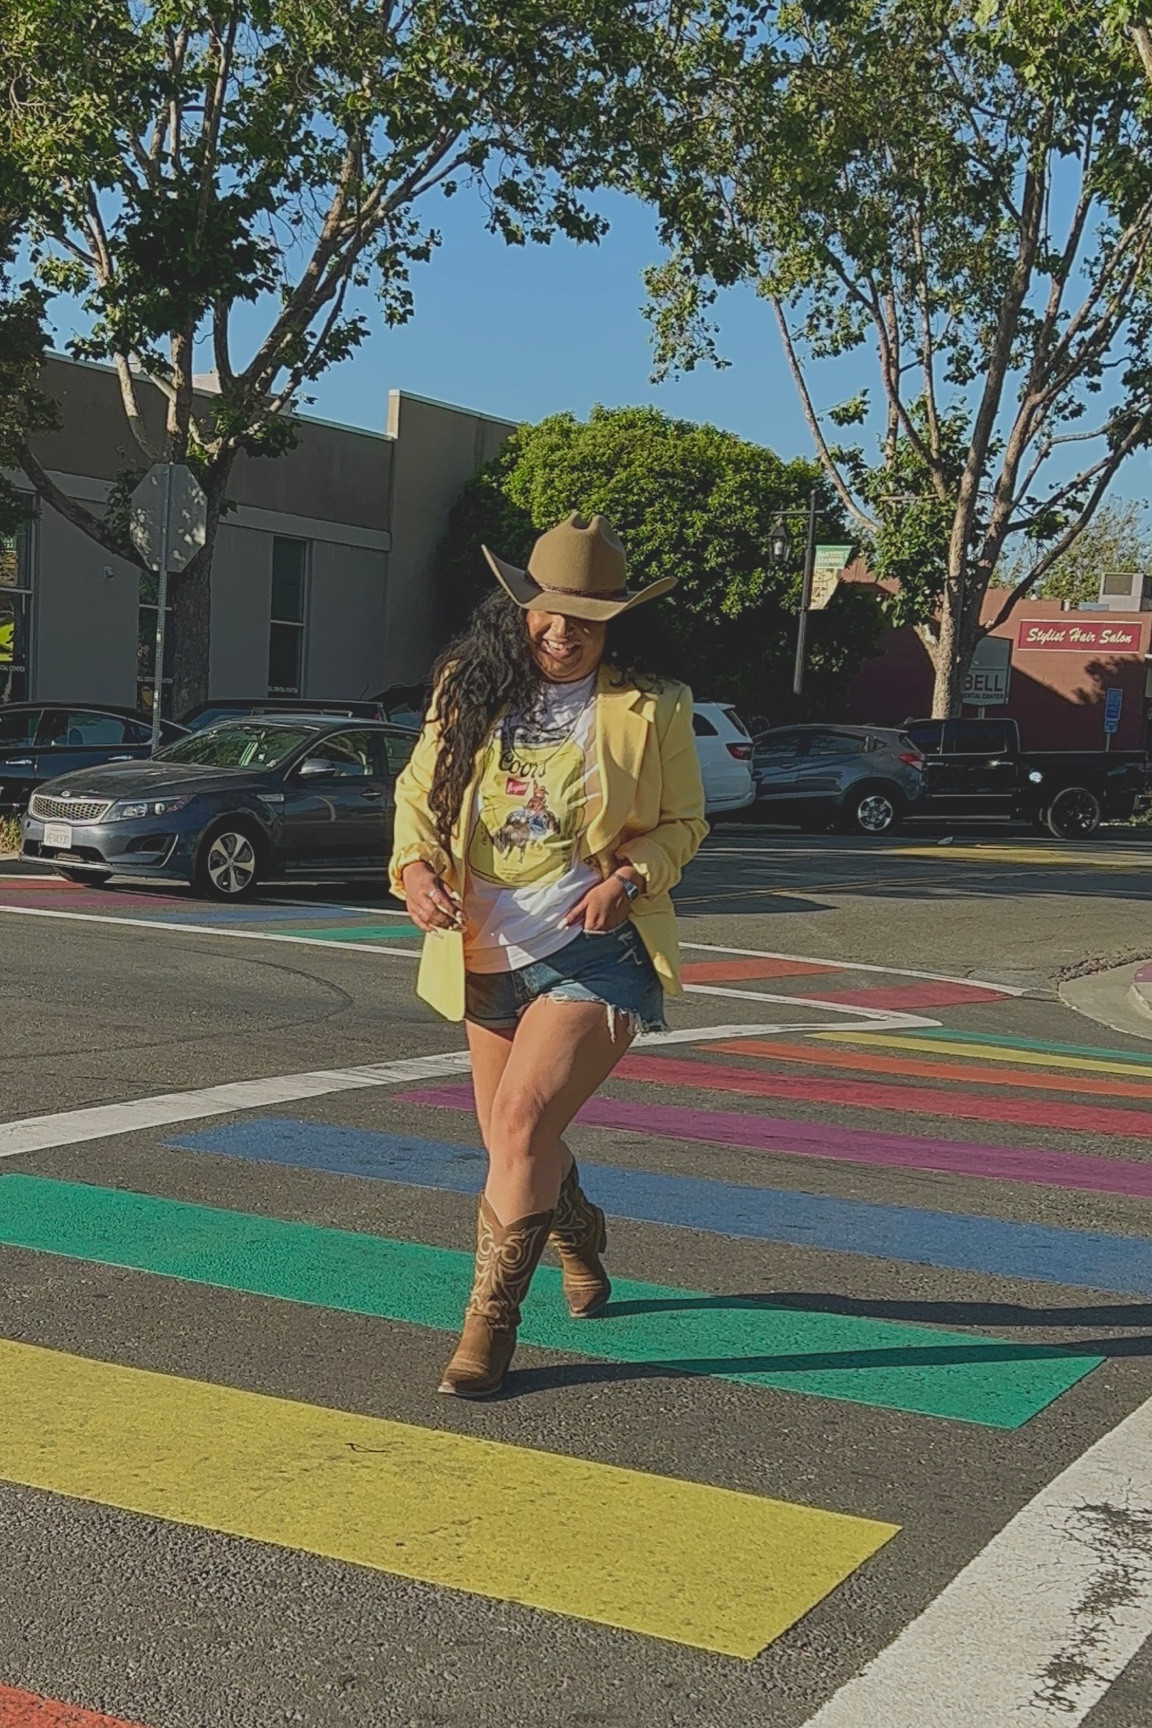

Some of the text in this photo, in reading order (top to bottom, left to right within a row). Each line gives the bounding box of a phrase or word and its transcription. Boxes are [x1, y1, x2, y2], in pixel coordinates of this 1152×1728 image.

[1027, 627, 1133, 645] Stylist Hair Salon
[963, 674, 1003, 692] BELL
